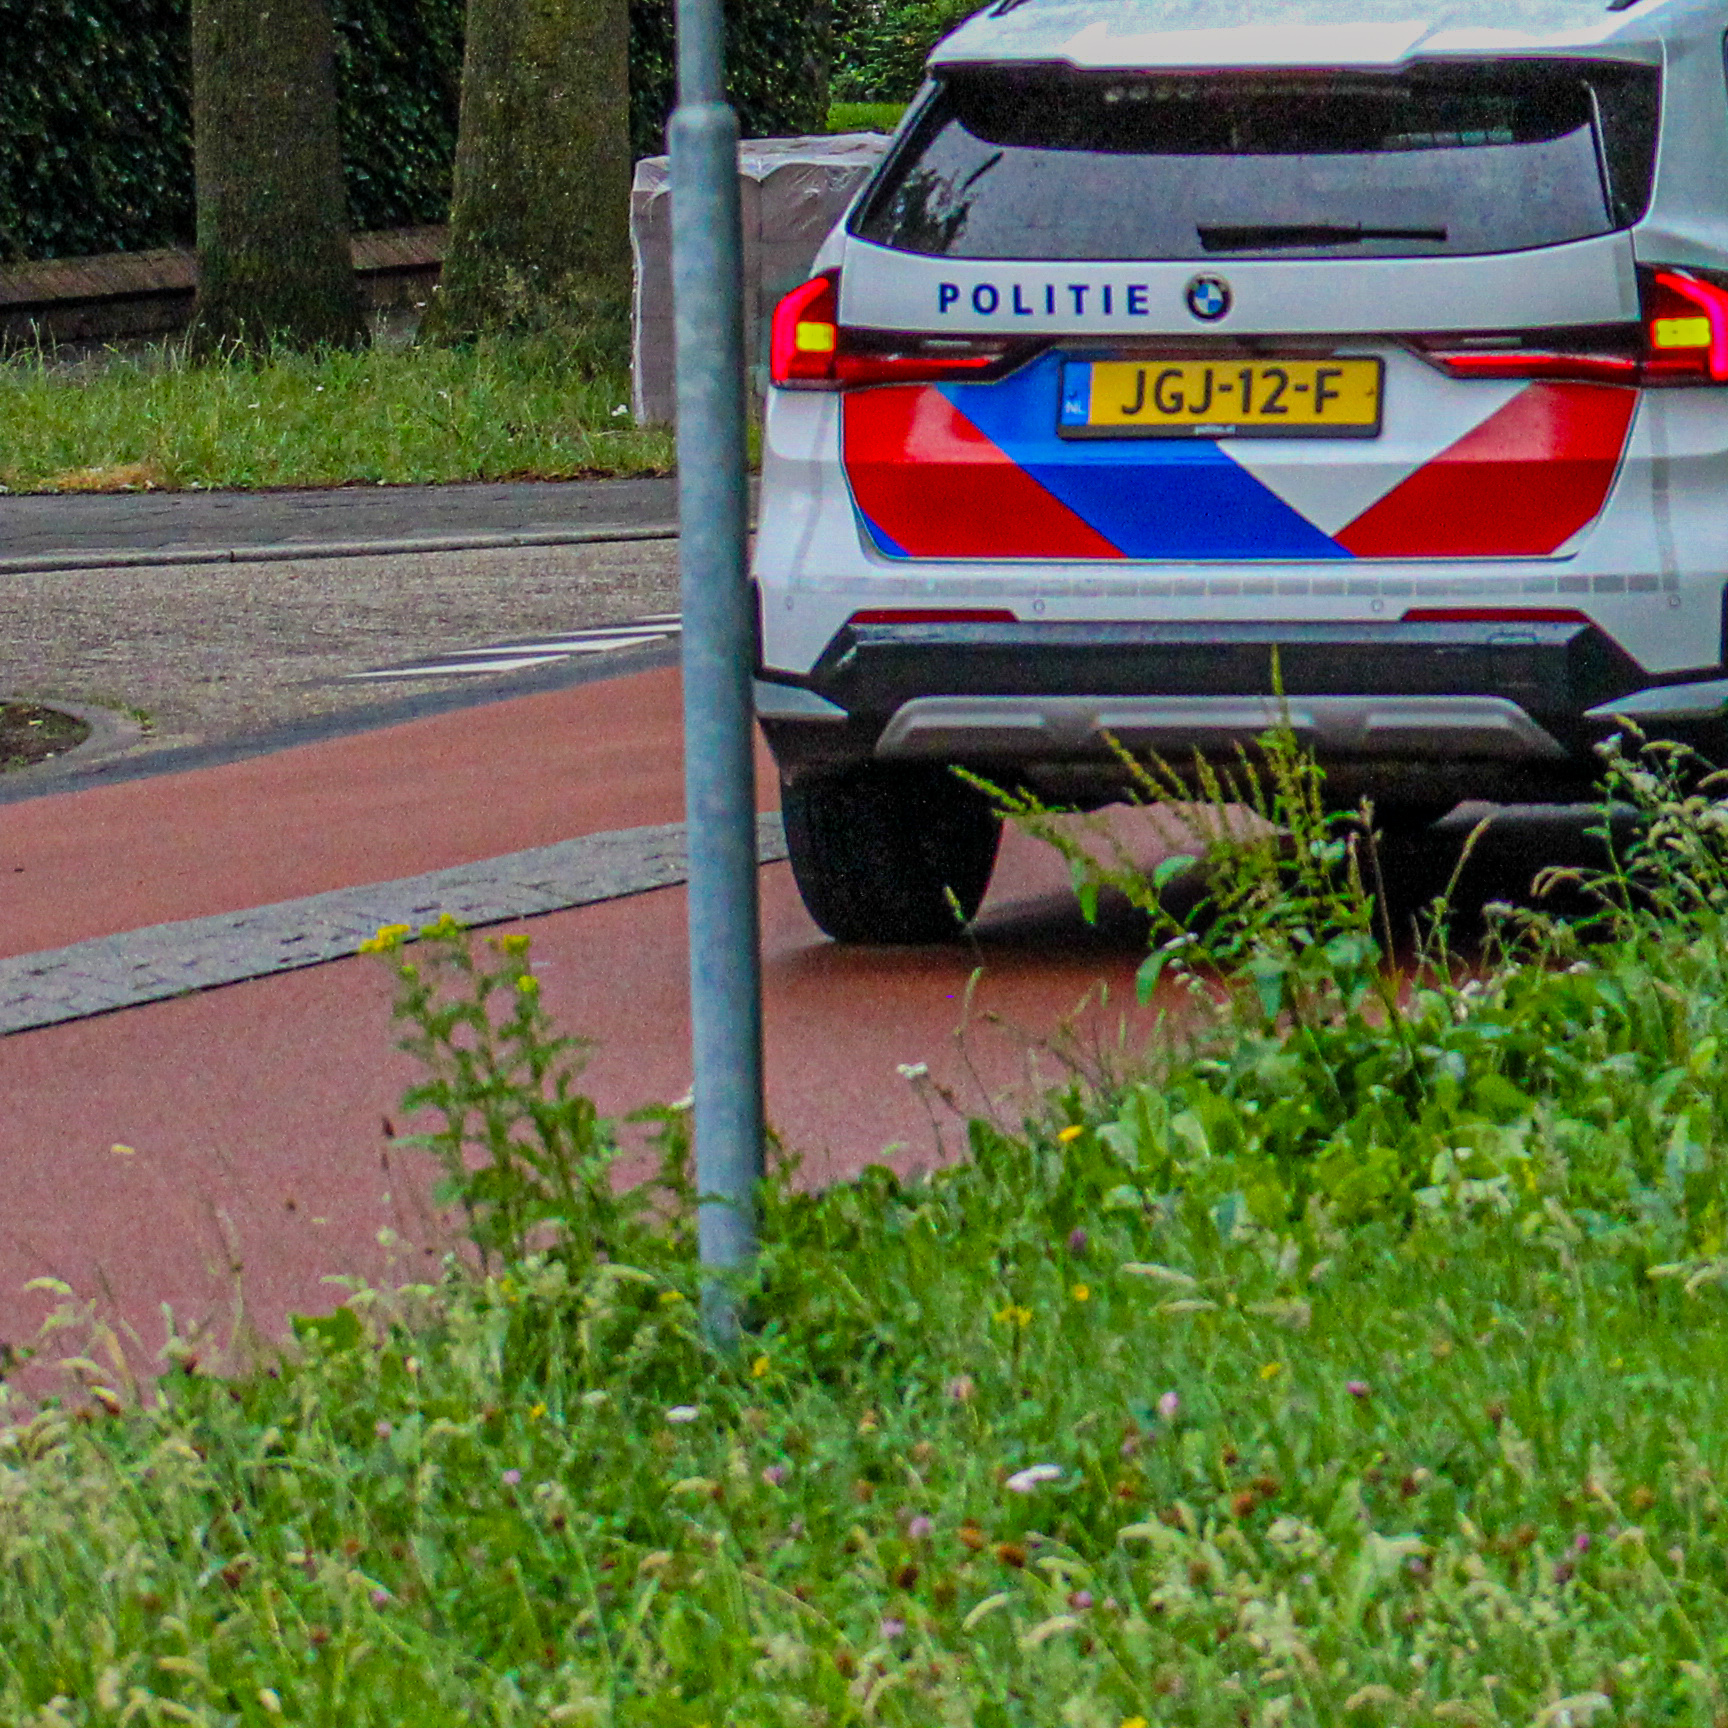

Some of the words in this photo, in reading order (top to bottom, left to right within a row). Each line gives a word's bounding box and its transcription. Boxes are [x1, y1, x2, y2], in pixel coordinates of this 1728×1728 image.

[937, 281, 1150, 316] POLITIE
[1064, 400, 1087, 415] NL
[1120, 367, 1343, 415] JGJ-12-F
